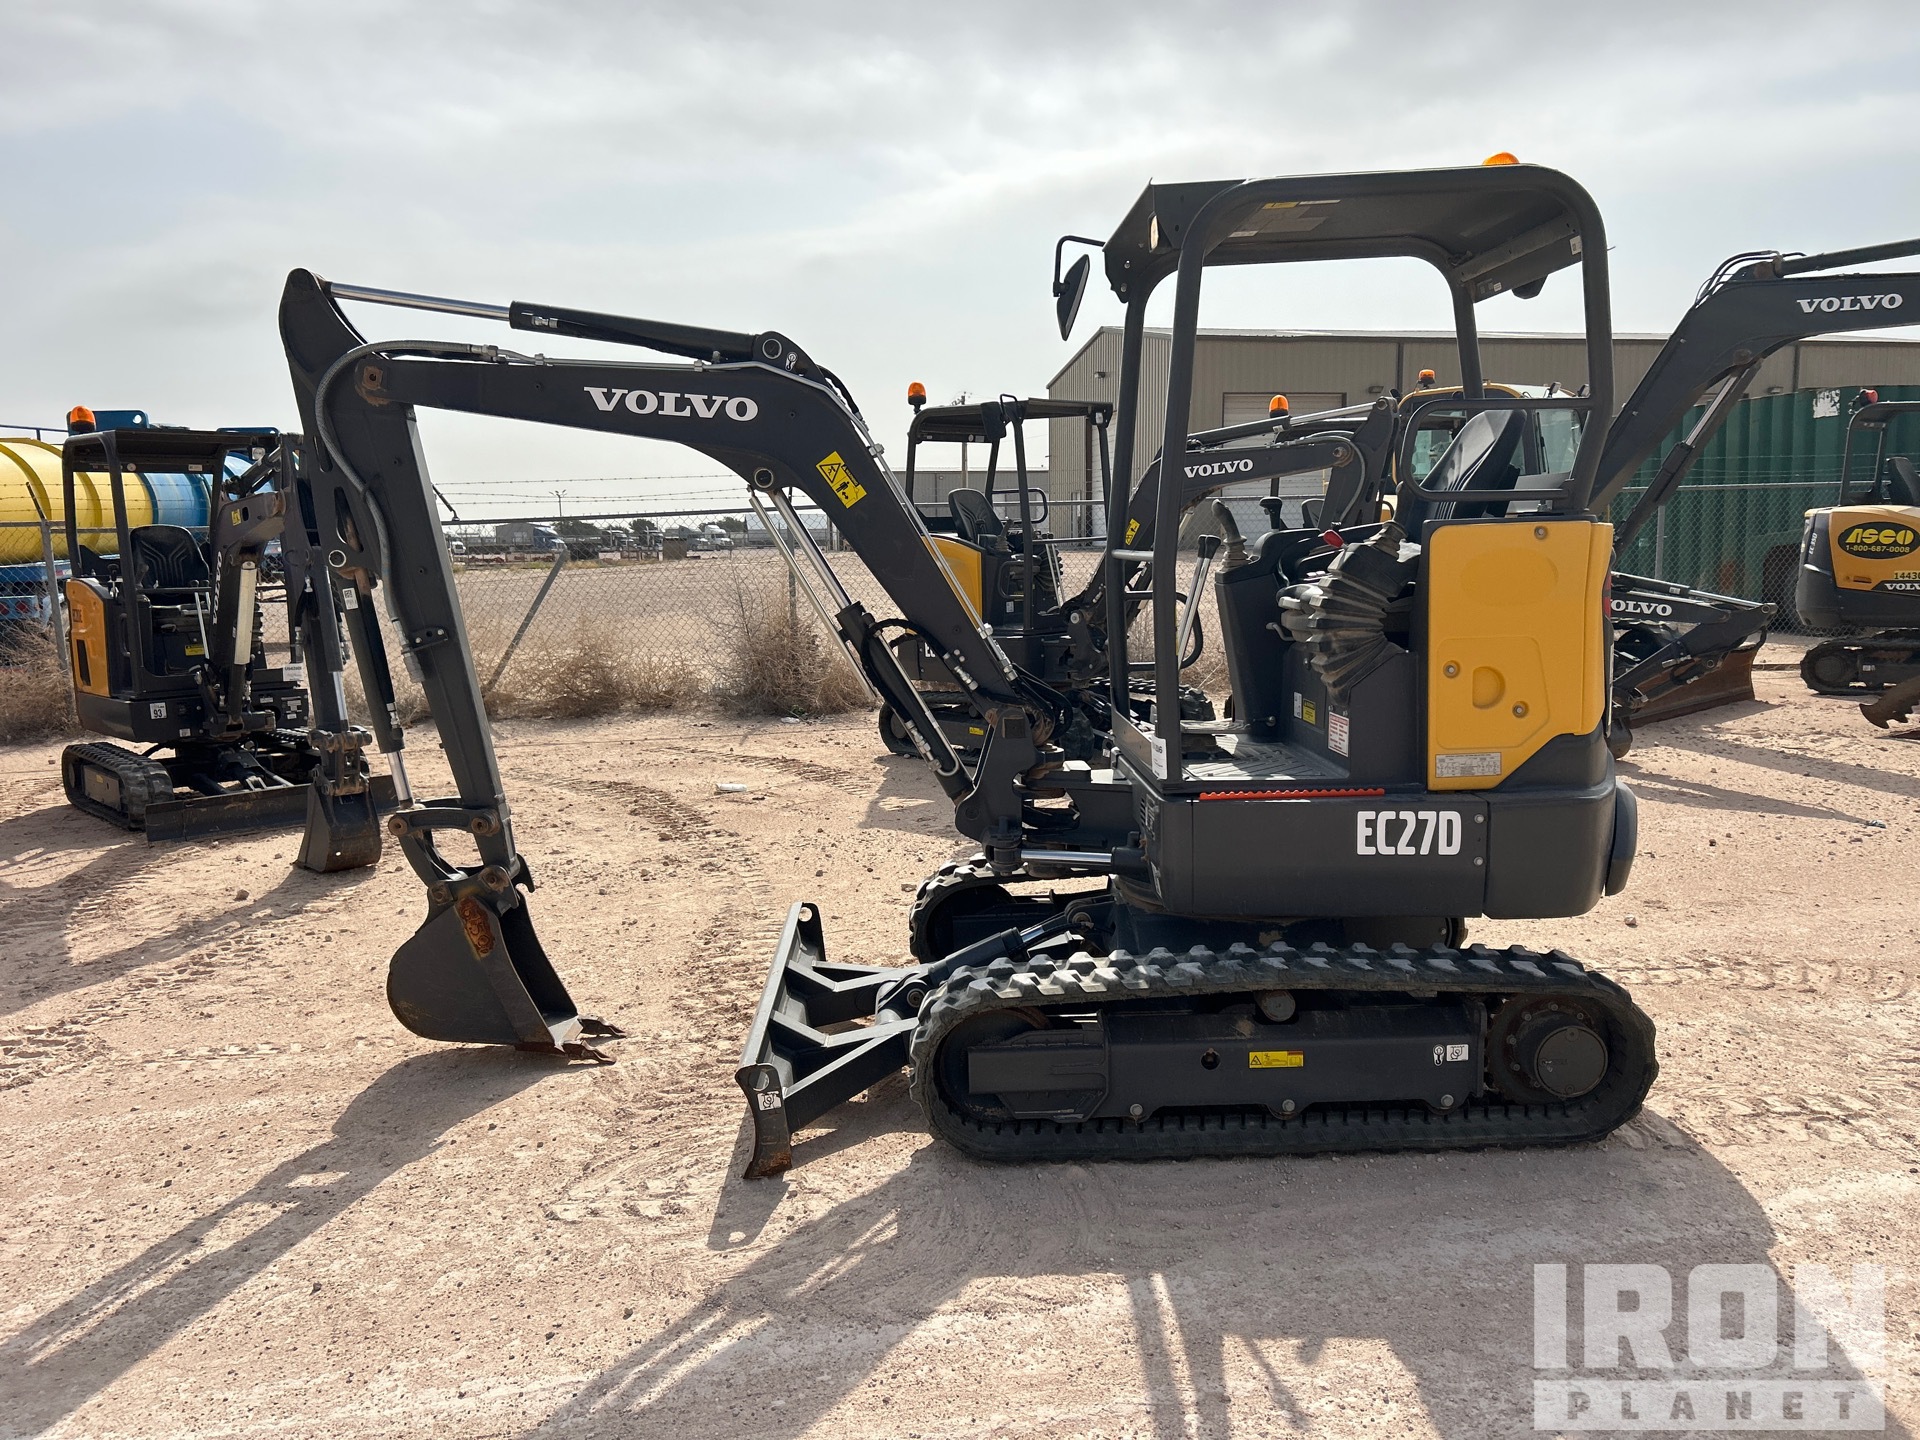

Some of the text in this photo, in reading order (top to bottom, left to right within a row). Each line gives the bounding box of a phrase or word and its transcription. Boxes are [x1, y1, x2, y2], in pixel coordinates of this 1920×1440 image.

[1796, 293, 1903, 313] VOLVO
[583, 386, 759, 422] VOLVO
[1184, 458, 1254, 478] VOLVO
[1845, 528, 1915, 546] ASCO
[212, 550, 223, 625] VOLVO
[1610, 599, 1673, 617] OLVO
[1356, 810, 1462, 856] EC27D
